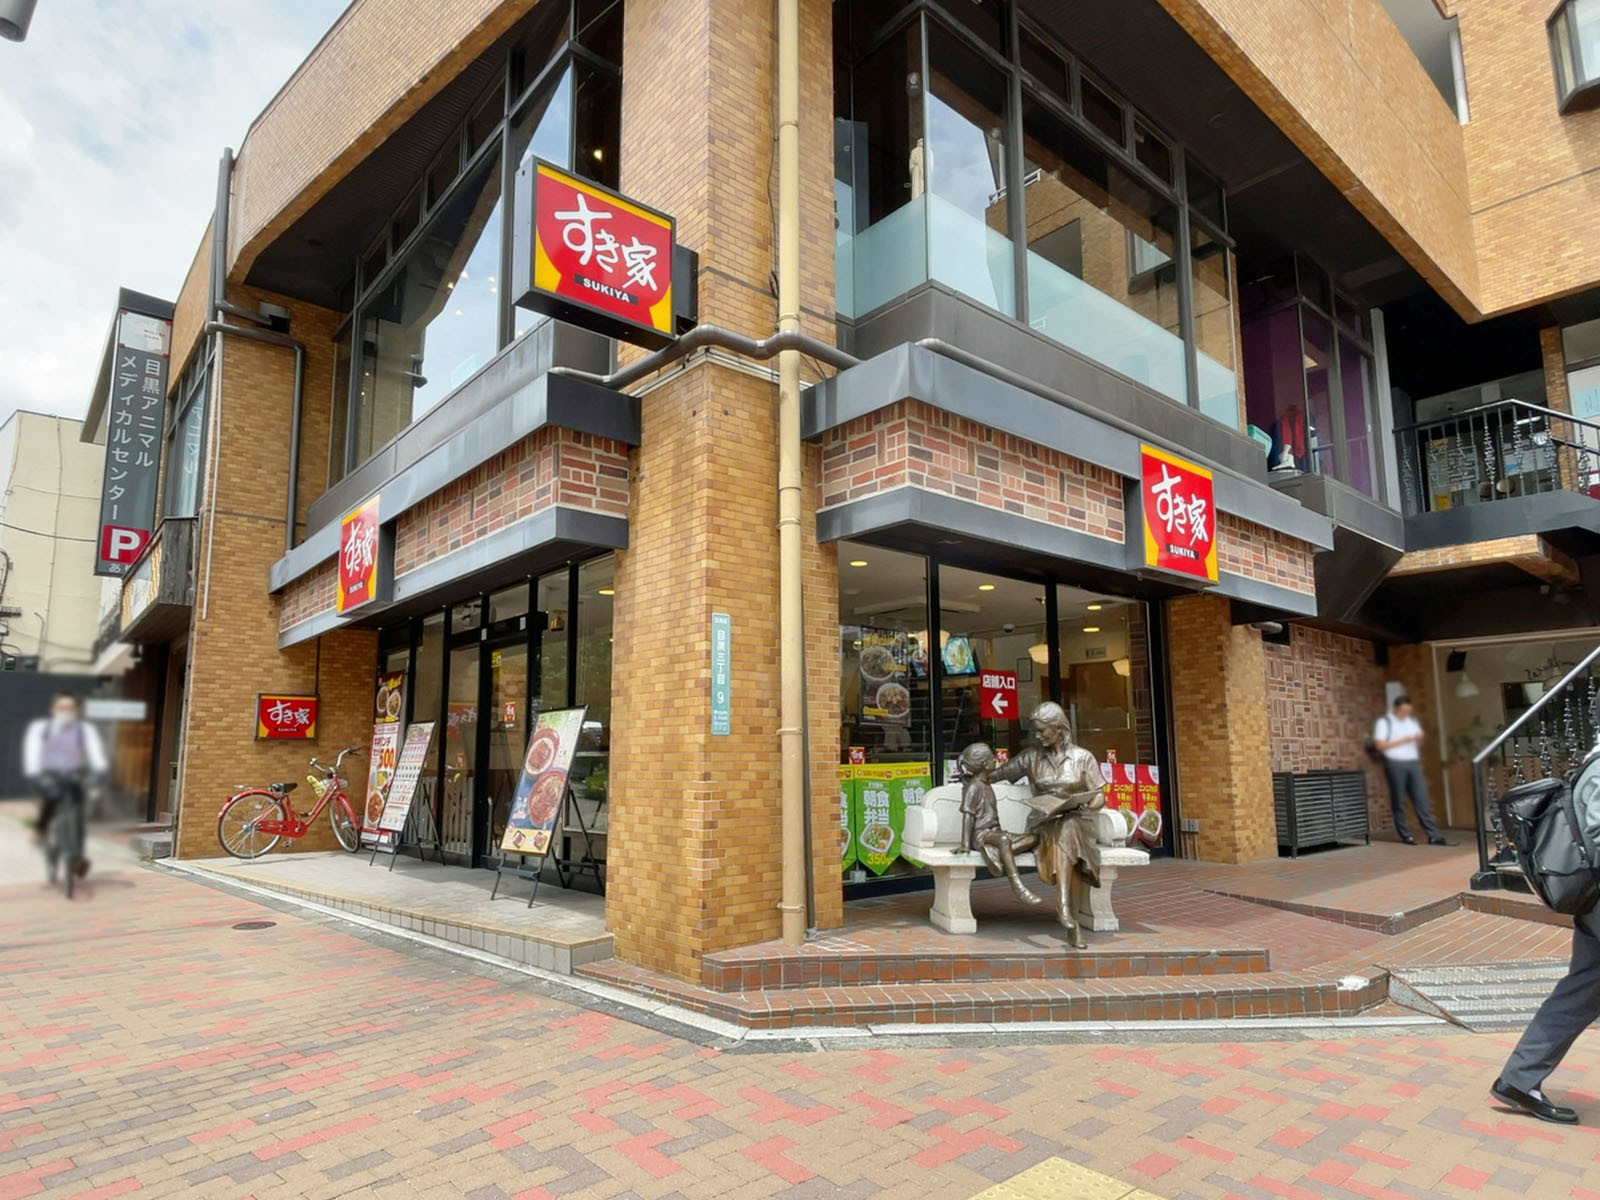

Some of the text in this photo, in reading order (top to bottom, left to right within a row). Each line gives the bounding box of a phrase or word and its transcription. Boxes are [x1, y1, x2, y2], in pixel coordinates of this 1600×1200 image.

[554, 192, 658, 292] すき家
[582, 277, 631, 303] SUKIYA
[135, 358, 161, 467] 目黒アニマル
[108, 355, 139, 521] メディカルセンター
[1151, 463, 1209, 547] すき家
[109, 527, 141, 560] P
[344, 521, 375, 579] すき家
[1169, 545, 1196, 559] SUKIYA
[982, 674, 1016, 690] 店舗入口
[716, 690, 725, 704] 9
[267, 700, 310, 727] すき家
[863, 790, 890, 807] 朝食
[864, 808, 890, 825] 弁当
